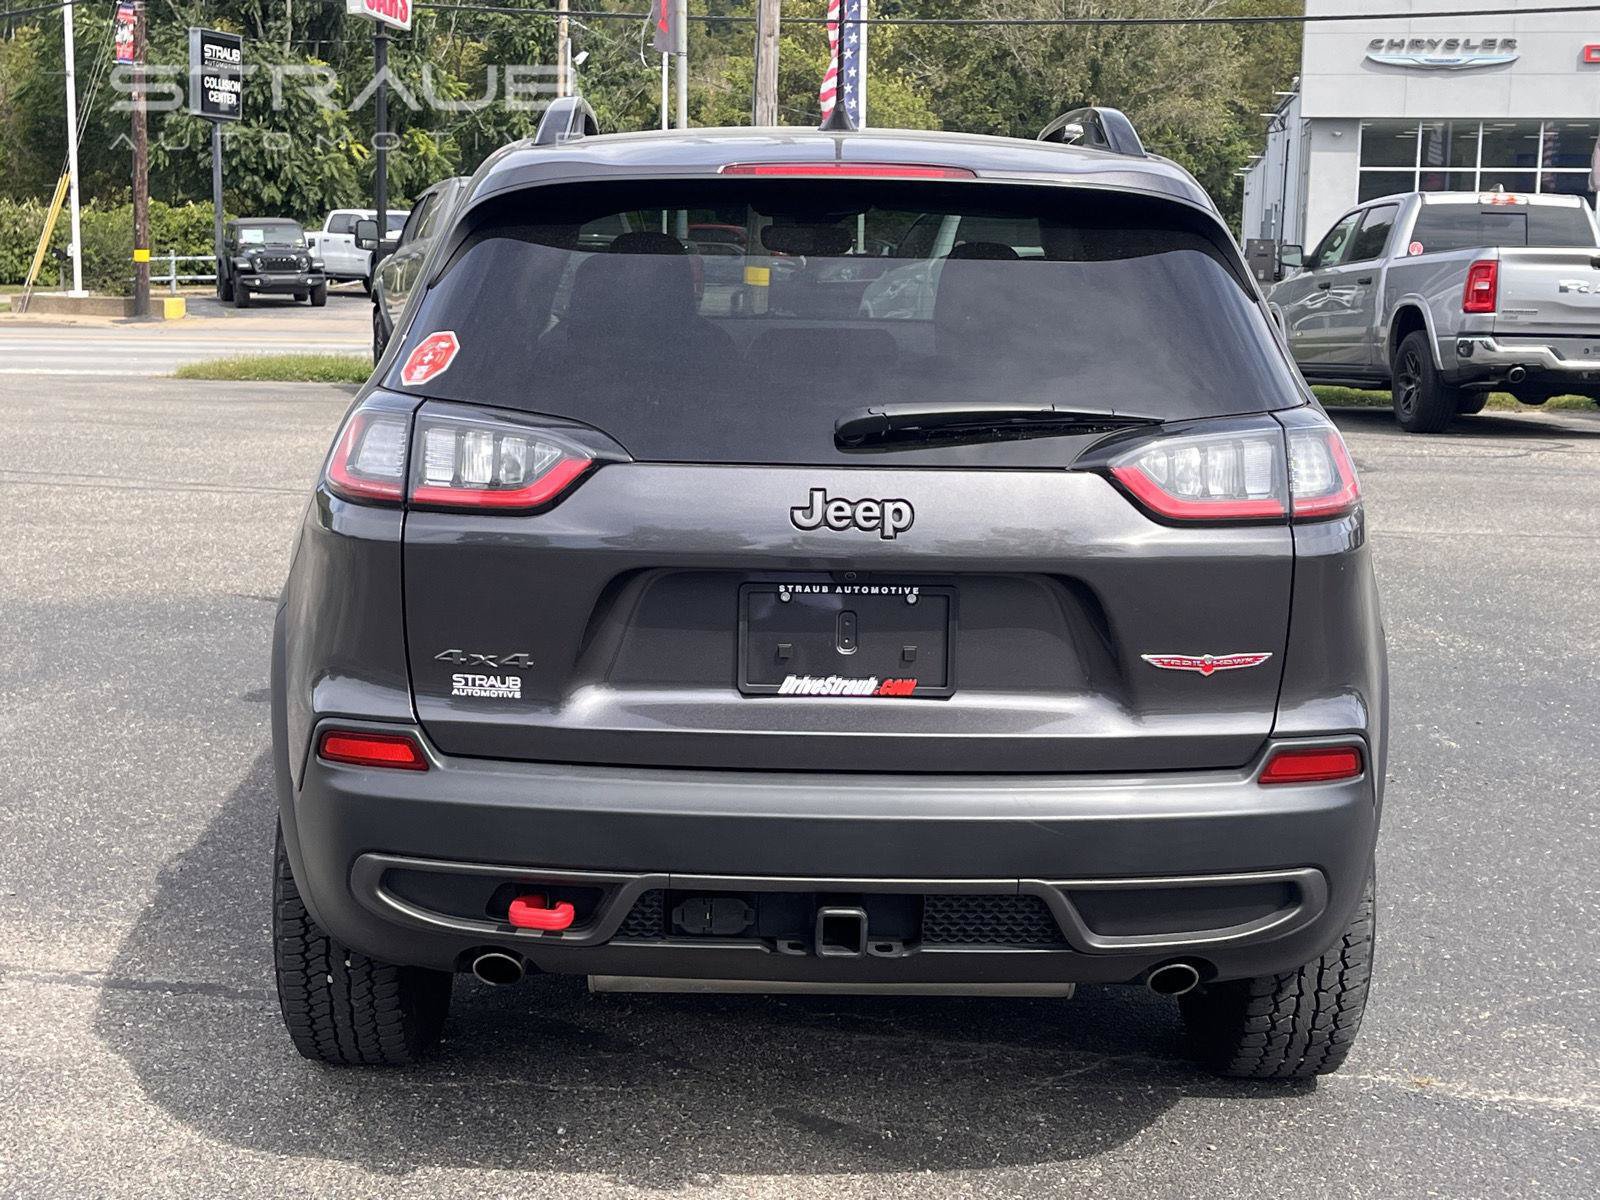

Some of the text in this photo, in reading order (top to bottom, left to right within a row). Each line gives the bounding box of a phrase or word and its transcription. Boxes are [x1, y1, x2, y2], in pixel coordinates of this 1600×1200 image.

[1367, 38, 1518, 51] CHRYSLER
[204, 44, 240, 62] STRAUB
[204, 76, 240, 93] COLLISION
[208, 90, 237, 105] CENTER
[790, 487, 915, 540] Jeep
[778, 584, 920, 595] STRAUB AUTOMOTIVE
[452, 673, 521, 689] STRAUB
[451, 688, 521, 698] AUTOMOTIVE
